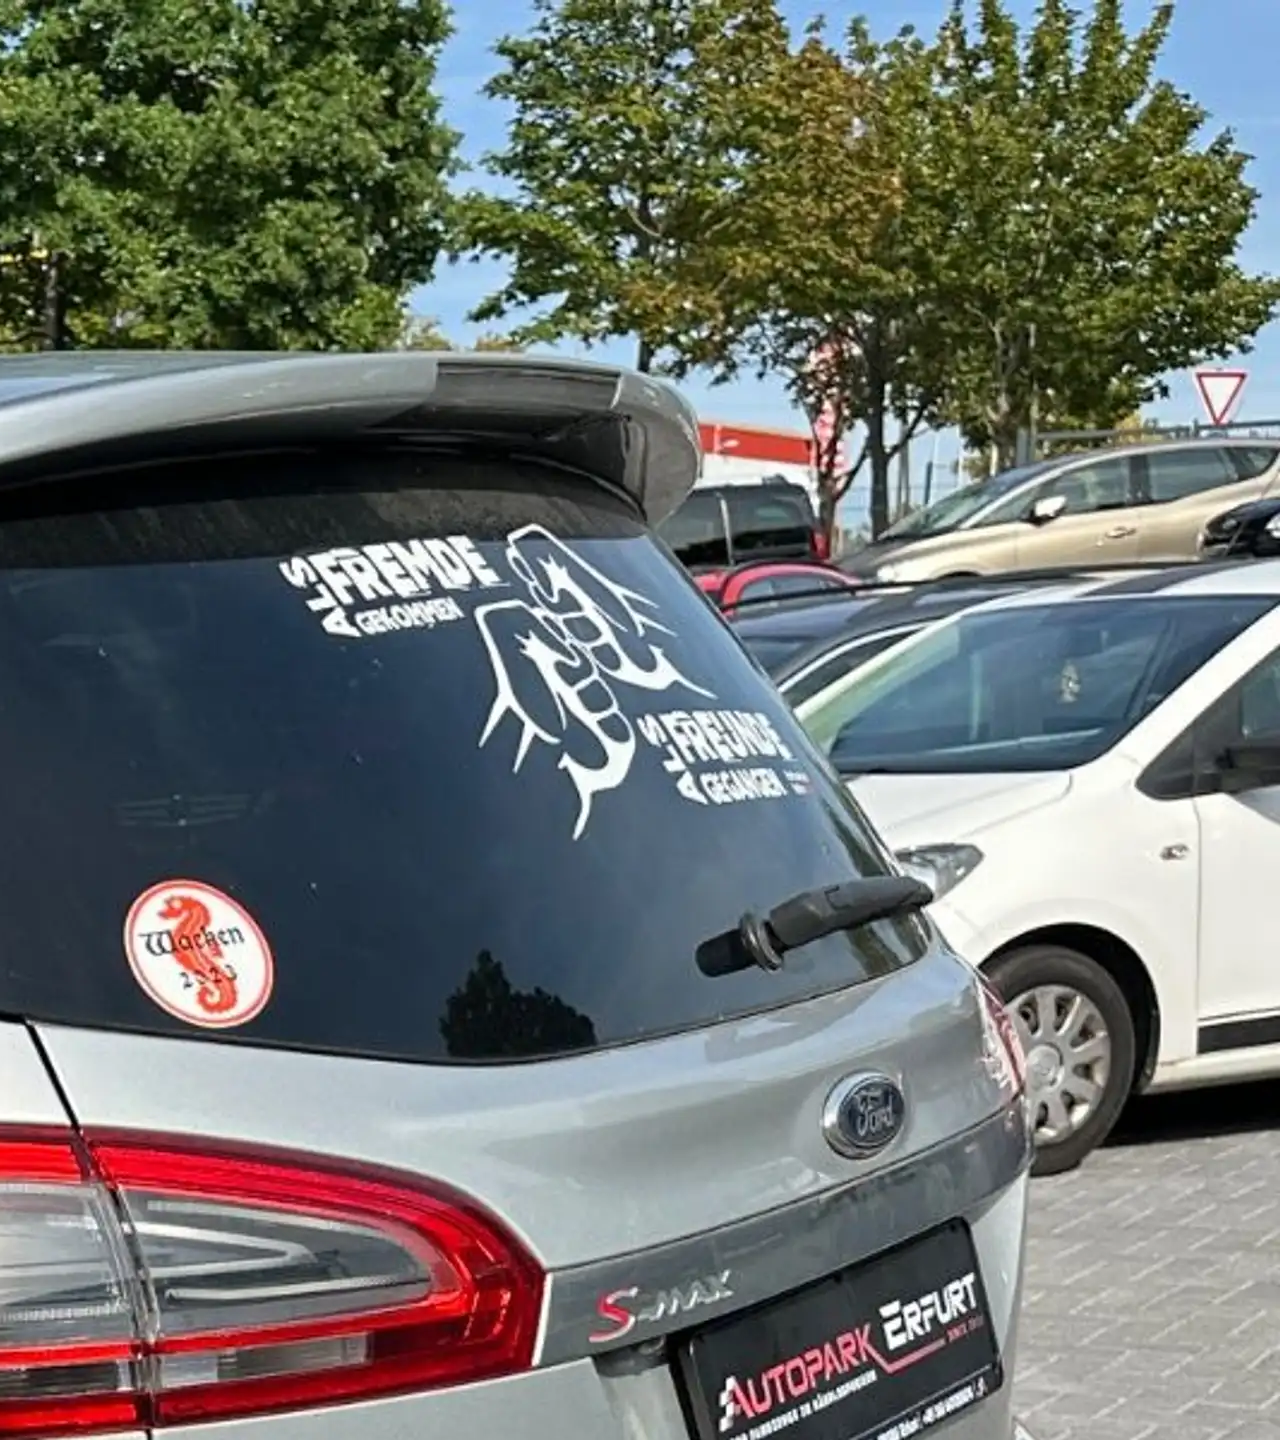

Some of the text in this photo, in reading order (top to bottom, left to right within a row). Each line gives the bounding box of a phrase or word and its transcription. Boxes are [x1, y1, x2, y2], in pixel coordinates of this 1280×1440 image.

[308, 535, 504, 606] FREMDE
[278, 556, 362, 638] ALS
[355, 597, 465, 636] GEKOMMEN
[658, 710, 794, 764] FREUNDE
[700, 768, 788, 805] GEGANGEN
[138, 926, 245, 957] Wacken
[855, 1088, 894, 1137] Ford
[719, 1322, 873, 1432] AUTOPARK
[878, 1271, 977, 1351] ERFURT
